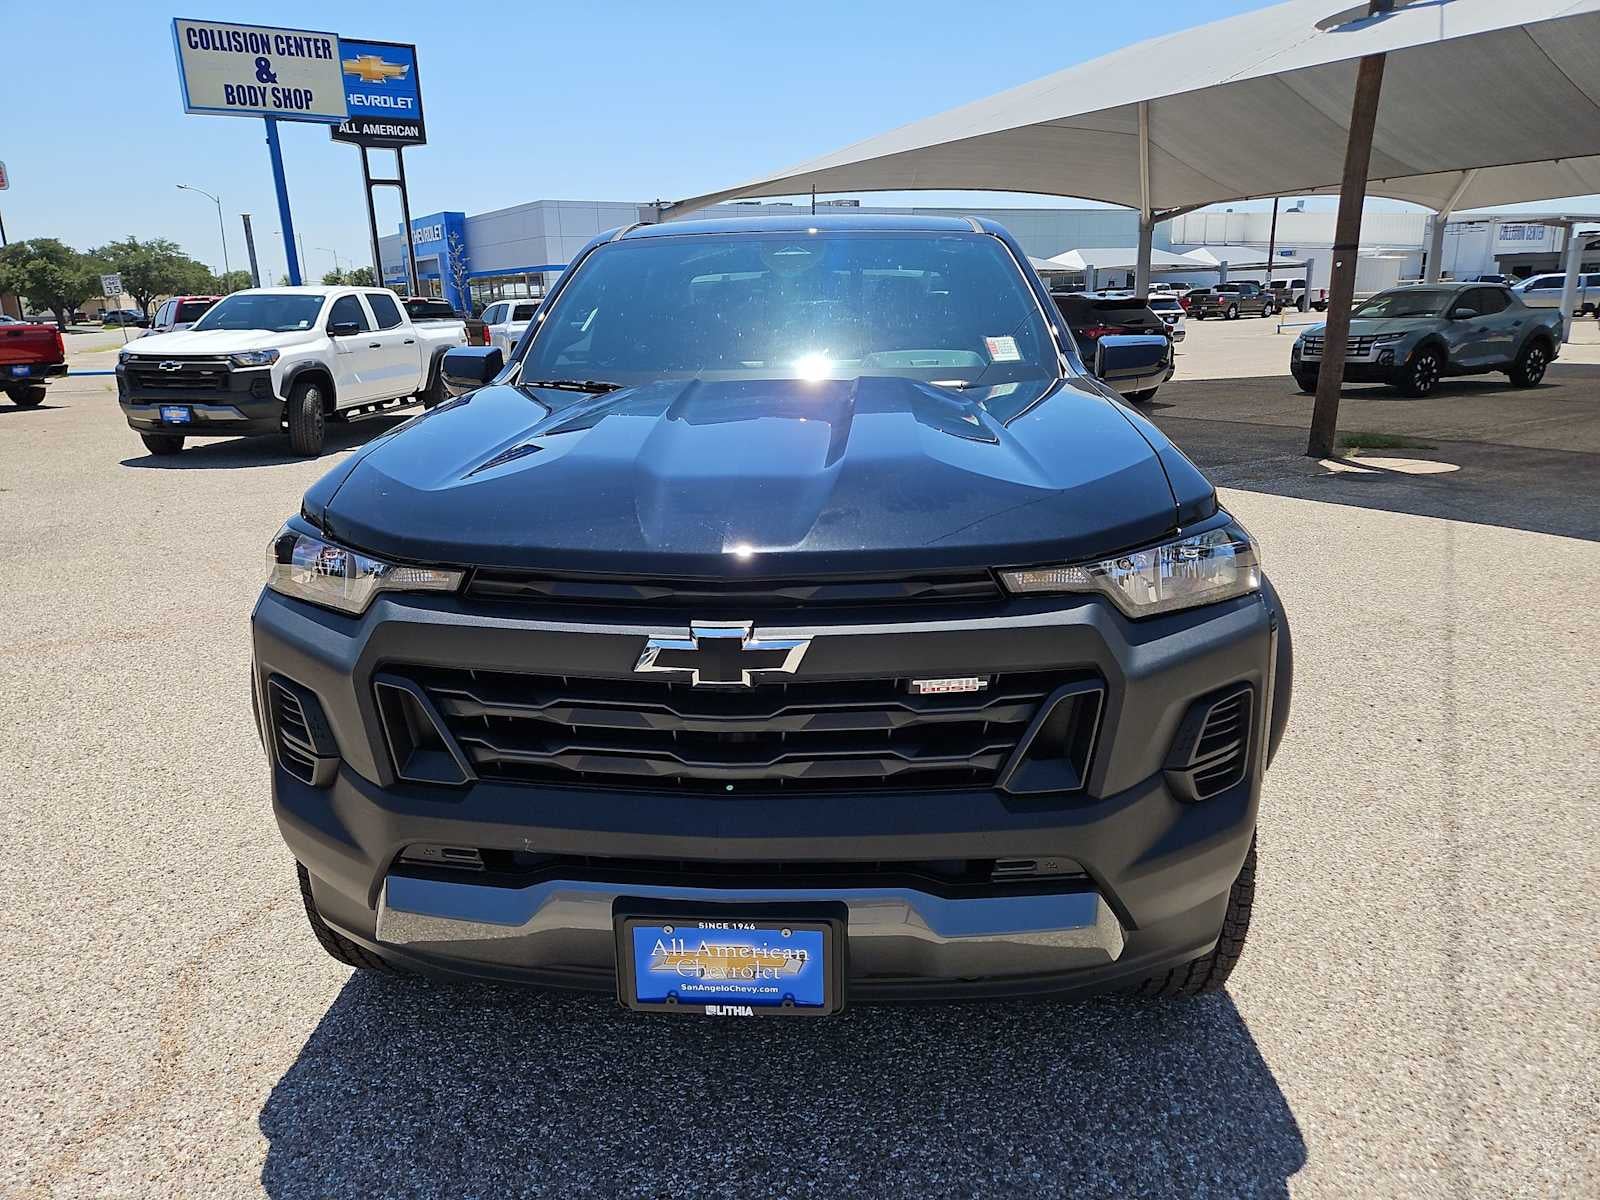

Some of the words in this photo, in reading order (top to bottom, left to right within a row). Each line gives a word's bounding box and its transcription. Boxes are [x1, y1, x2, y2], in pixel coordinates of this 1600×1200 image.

[186, 27, 272, 56] COLLISION
[274, 34, 333, 60] CENTER
[255, 56, 279, 84] &
[224, 84, 269, 107] BODY
[272, 87, 313, 110] SHOP
[347, 93, 414, 109] HEVROLET
[338, 122, 361, 134] ALL
[362, 123, 420, 137] AMERICAN
[106, 285, 121, 294] 35
[698, 921, 729, 930] SINCE
[732, 922, 756, 931] 1946
[650, 938, 686, 957] All
[695, 939, 810, 961] American
[675, 959, 783, 980] Chevrolet
[680, 983, 779, 994] SanAngeloChevy.com
[716, 1004, 754, 1017] LITHIA
